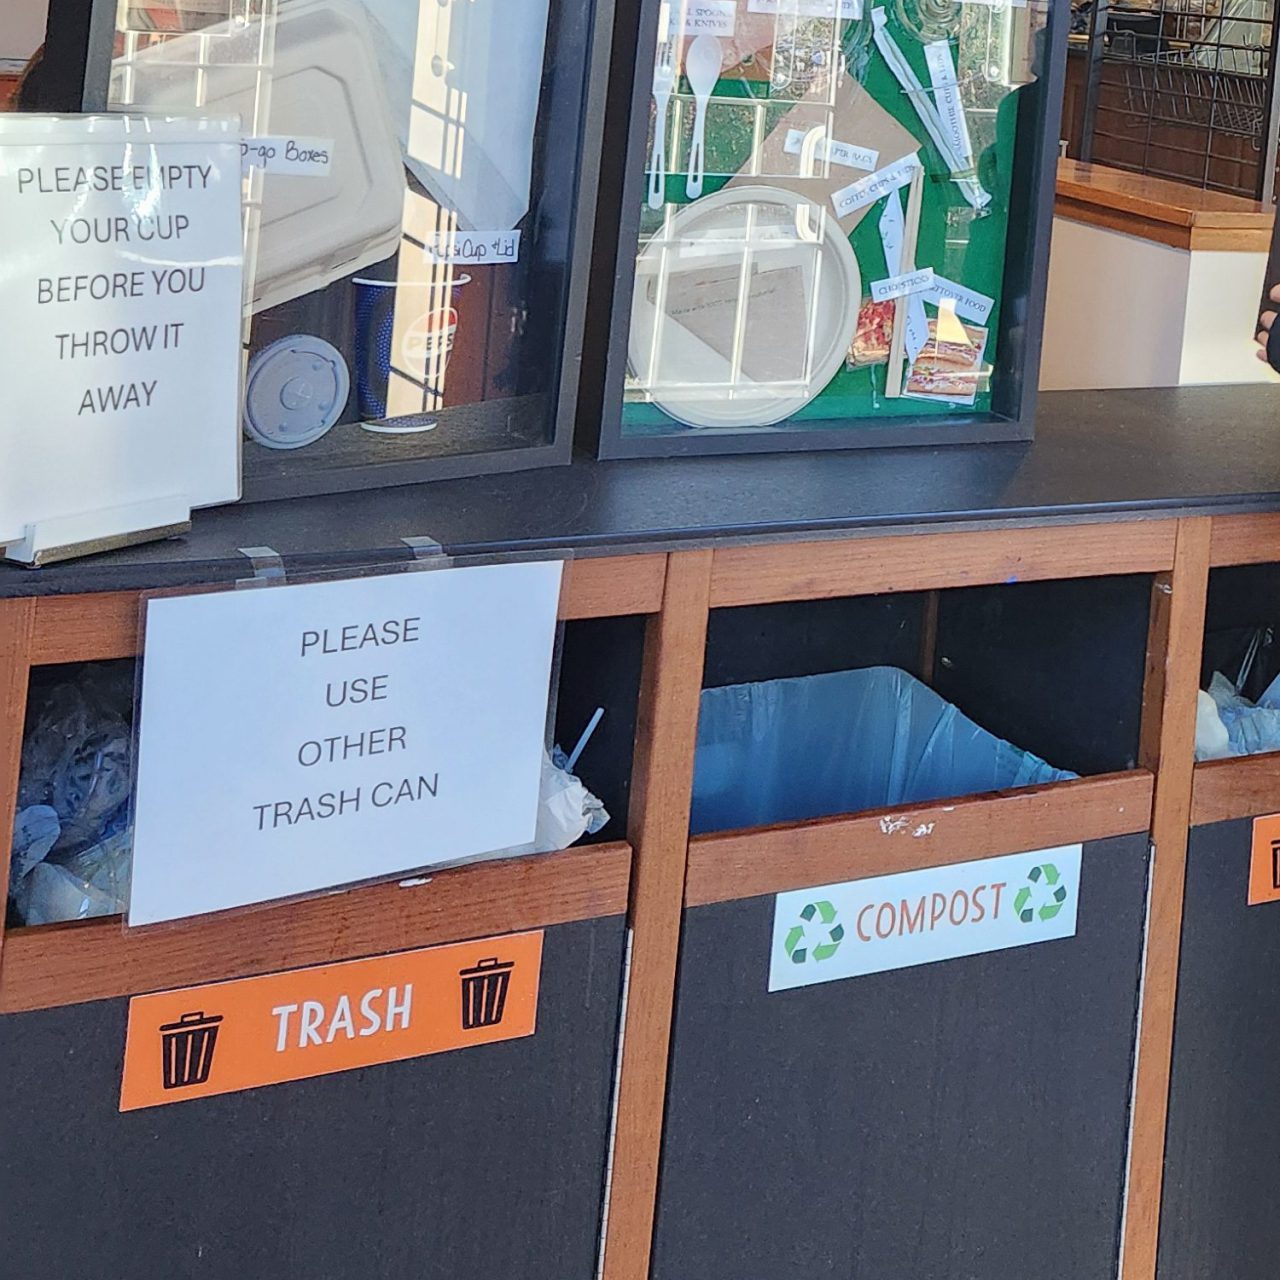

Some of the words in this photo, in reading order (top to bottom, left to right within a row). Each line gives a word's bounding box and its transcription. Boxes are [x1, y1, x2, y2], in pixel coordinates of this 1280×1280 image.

[240, 138, 276, 169] o-go
[285, 140, 329, 164] Boxes
[18, 166, 125, 194] PLEASE
[133, 165, 212, 190] EMPTY
[50, 217, 130, 245] YOUR
[136, 215, 189, 240] CUP
[37, 272, 145, 304] BEFORE
[152, 267, 206, 295] YOU
[55, 325, 157, 360] THROW
[163, 323, 184, 349] IT
[77, 380, 158, 416] AWAY
[301, 617, 421, 657] PLEASE
[325, 675, 389, 707] USE
[297, 726, 407, 767] OTHER
[253, 787, 360, 830] TRASH
[371, 773, 439, 807] CAN
[855, 882, 1007, 943] COMPOST
[271, 983, 414, 1053] TRASH
